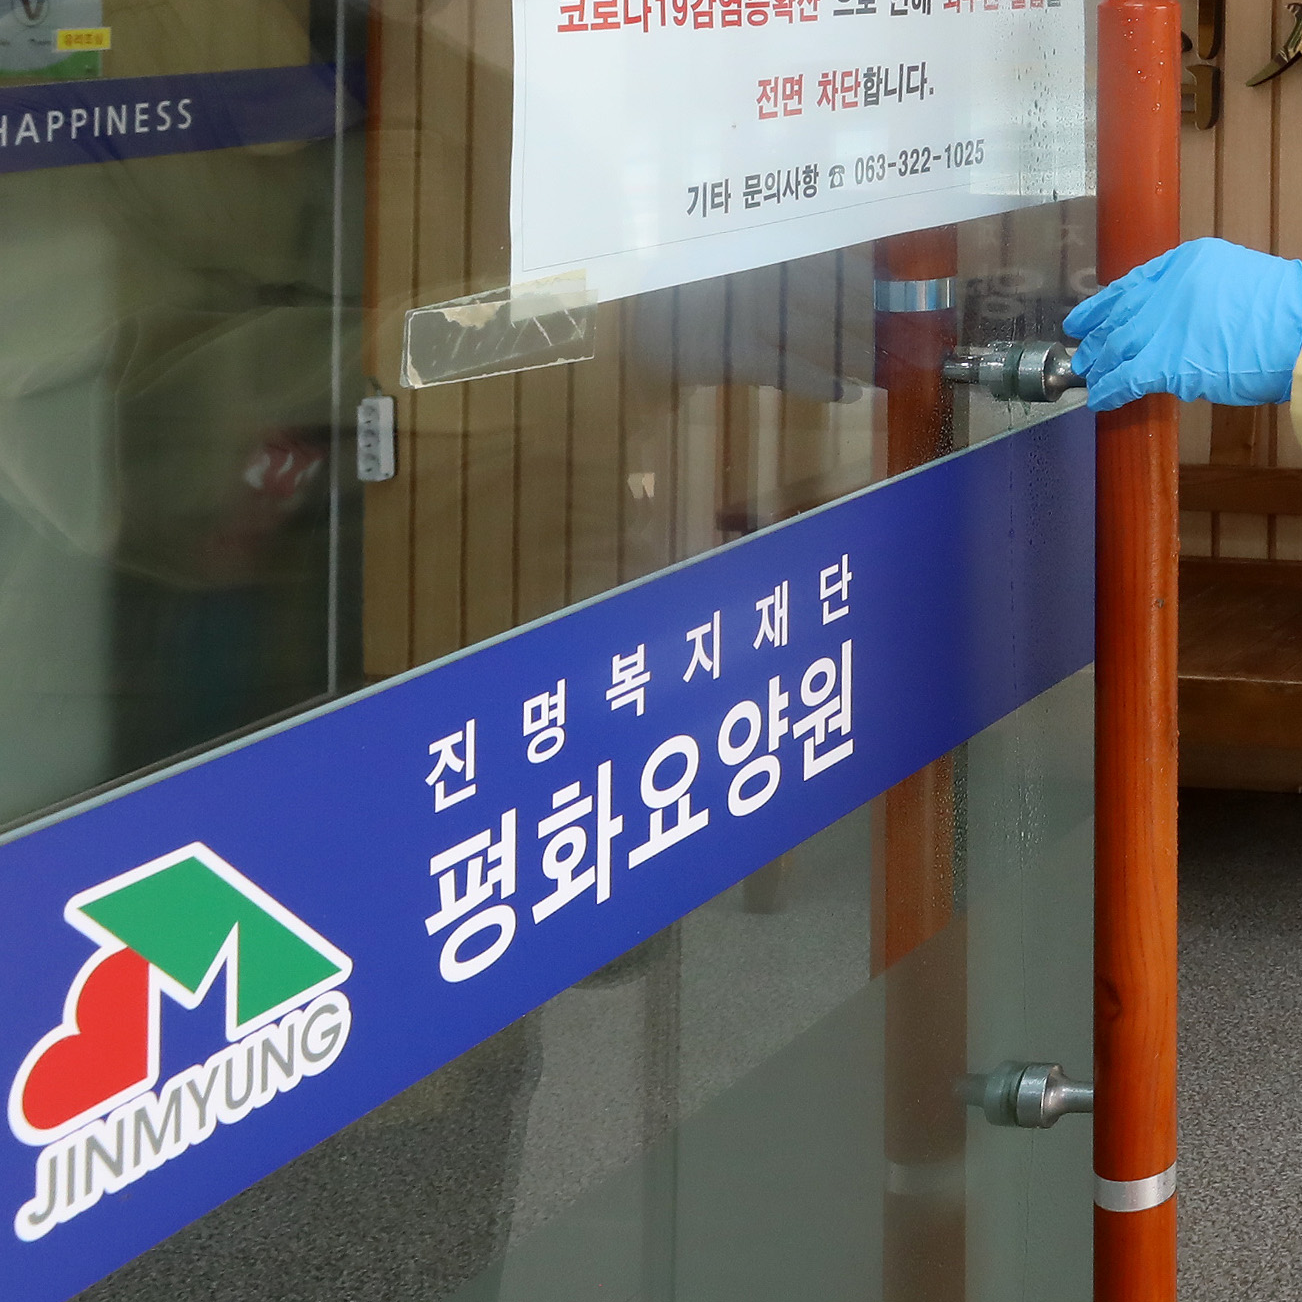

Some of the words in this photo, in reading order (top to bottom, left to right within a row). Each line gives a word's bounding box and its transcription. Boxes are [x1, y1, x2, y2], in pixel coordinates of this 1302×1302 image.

[685, 178, 731, 220] 기타
[742, 162, 819, 208] 문의사항
[853, 138, 985, 187] 063-322-1025
[754, 73, 804, 121] 전면
[816, 61, 935, 112] 차단합니다.
[423, 552, 853, 815] 진명복지재단
[423, 639, 856, 985] 평화요양원
[27, 1003, 343, 1227] JINMYUNG
